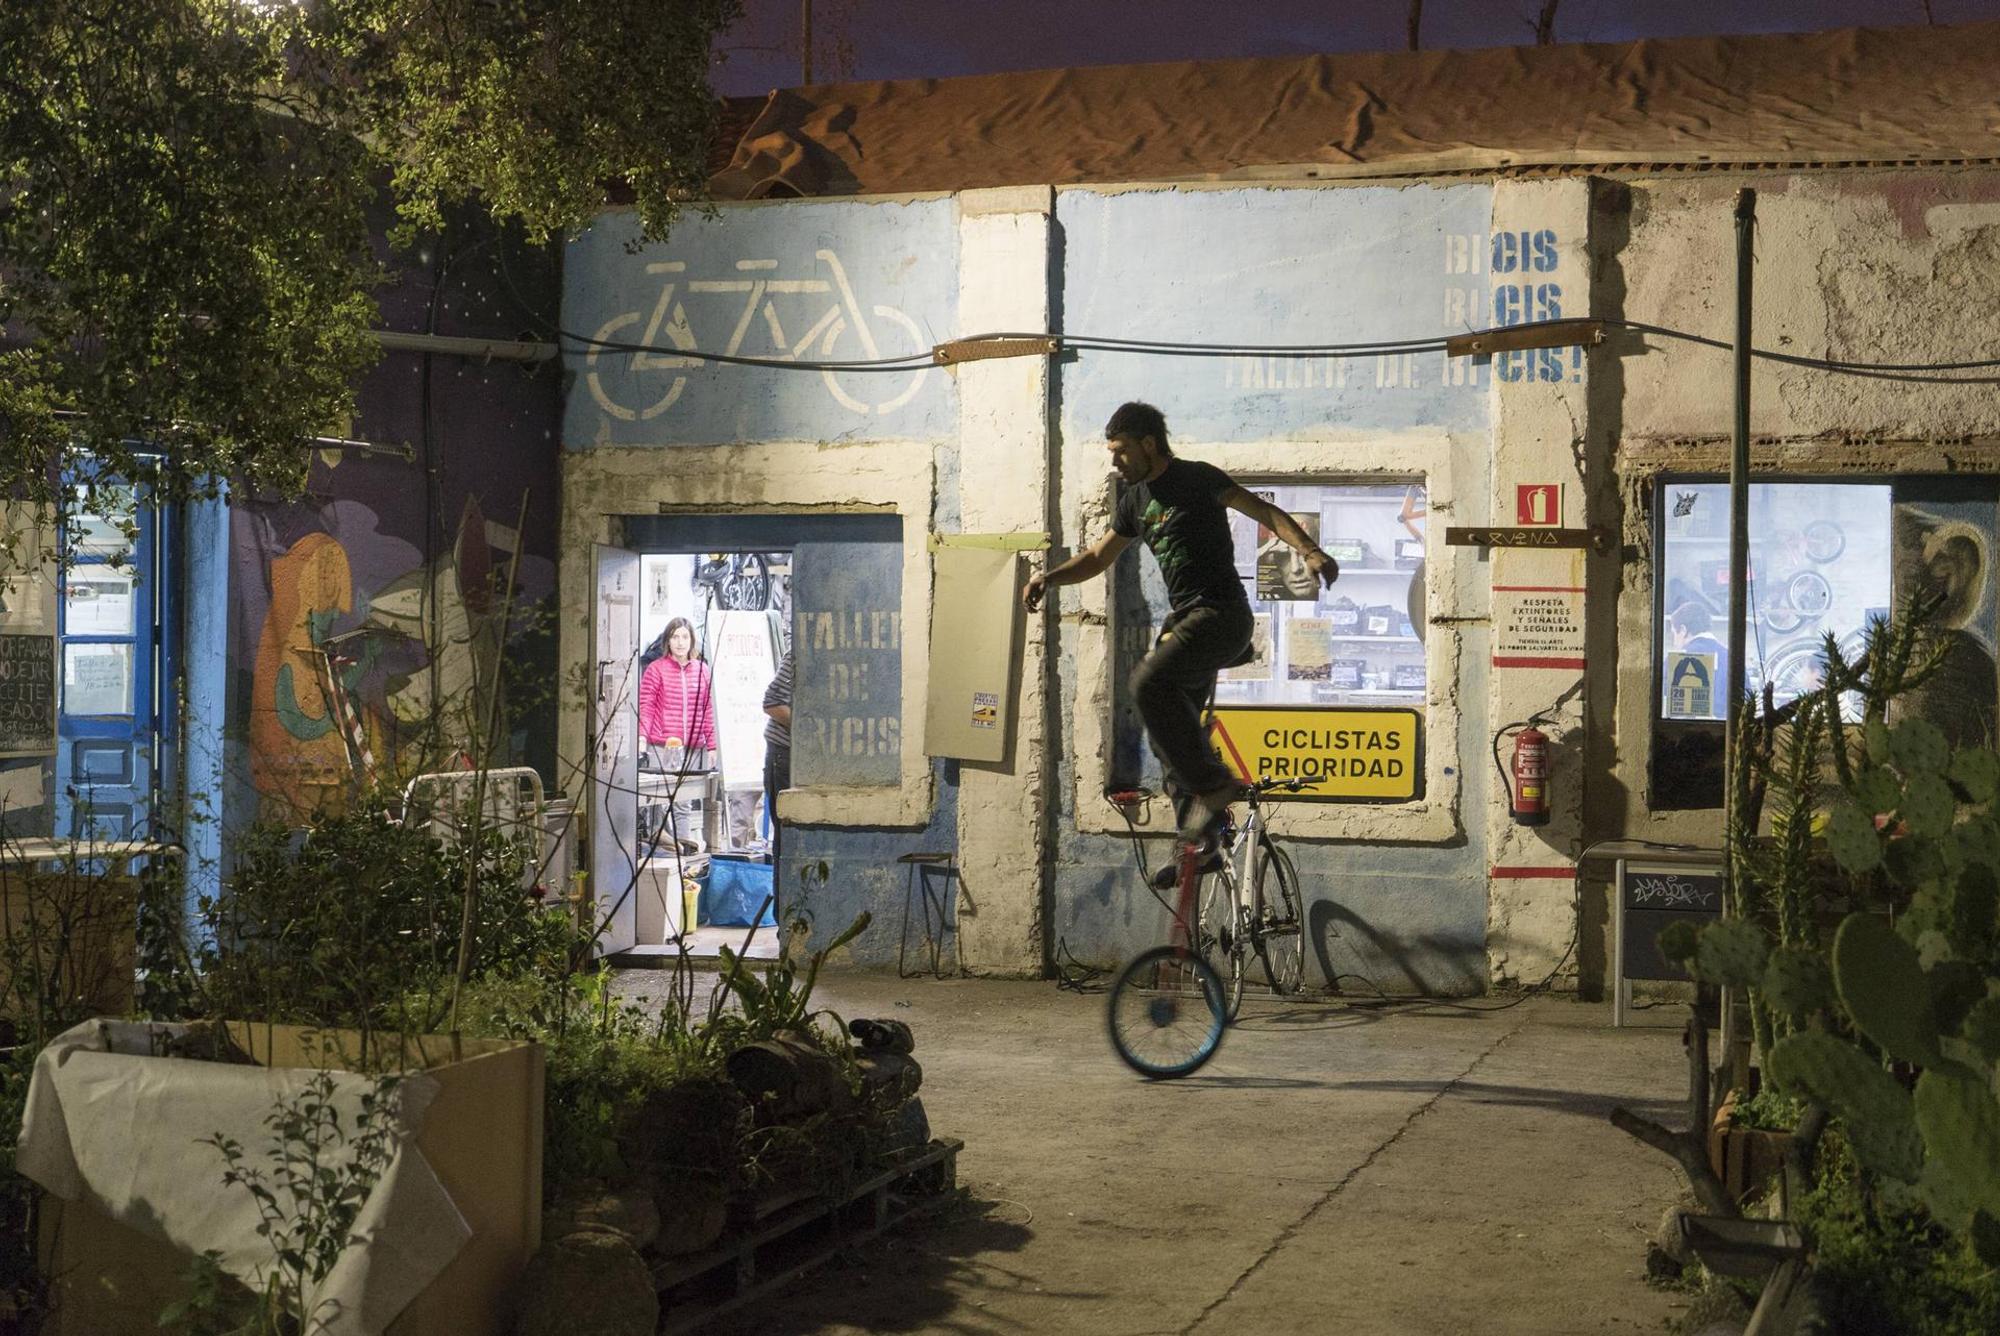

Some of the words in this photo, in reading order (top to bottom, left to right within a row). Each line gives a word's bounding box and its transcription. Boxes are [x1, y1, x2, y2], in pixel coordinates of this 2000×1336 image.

[1446, 230, 1558, 274] BICIS
[1443, 284, 1561, 328] BICIS
[1376, 353, 1421, 389] DE
[1442, 344, 1581, 387] BICIS!
[1512, 607, 1571, 615] EXTINTORES
[1522, 599, 1565, 607] RESPETA
[1518, 616, 1523, 624] Y
[1523, 625, 1578, 633] SEGURIDAD
[0, 638, 17, 659] OR
[829, 663, 869, 700] DE
[0, 683, 46, 702] CEITE
[0, 702, 44, 721] SADO
[1264, 729, 1401, 750] CICLISTAS
[1258, 756, 1403, 778] PRIORIDAD
